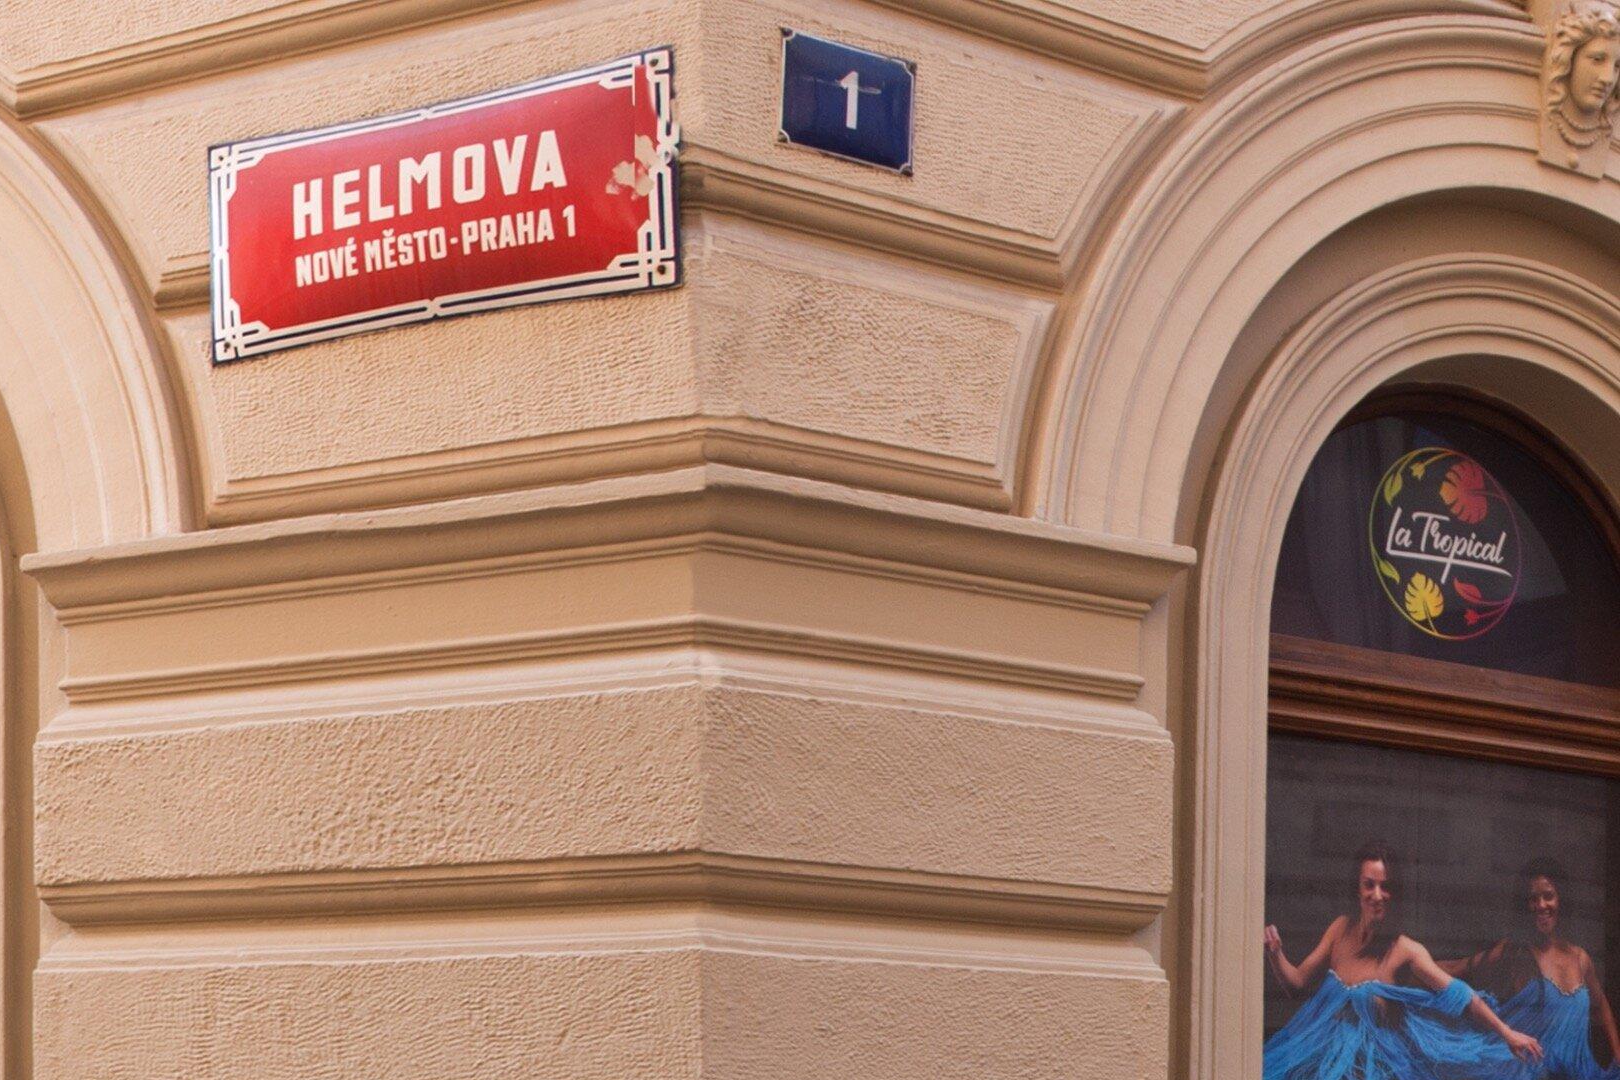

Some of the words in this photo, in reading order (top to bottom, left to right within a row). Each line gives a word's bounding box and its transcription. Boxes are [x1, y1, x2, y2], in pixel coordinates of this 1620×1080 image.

[840, 70, 859, 130] 1
[291, 129, 569, 241] HELMOVA
[295, 236, 359, 288] NOVÉ
[562, 204, 577, 239] 1
[1412, 511, 1507, 585] Tropical
